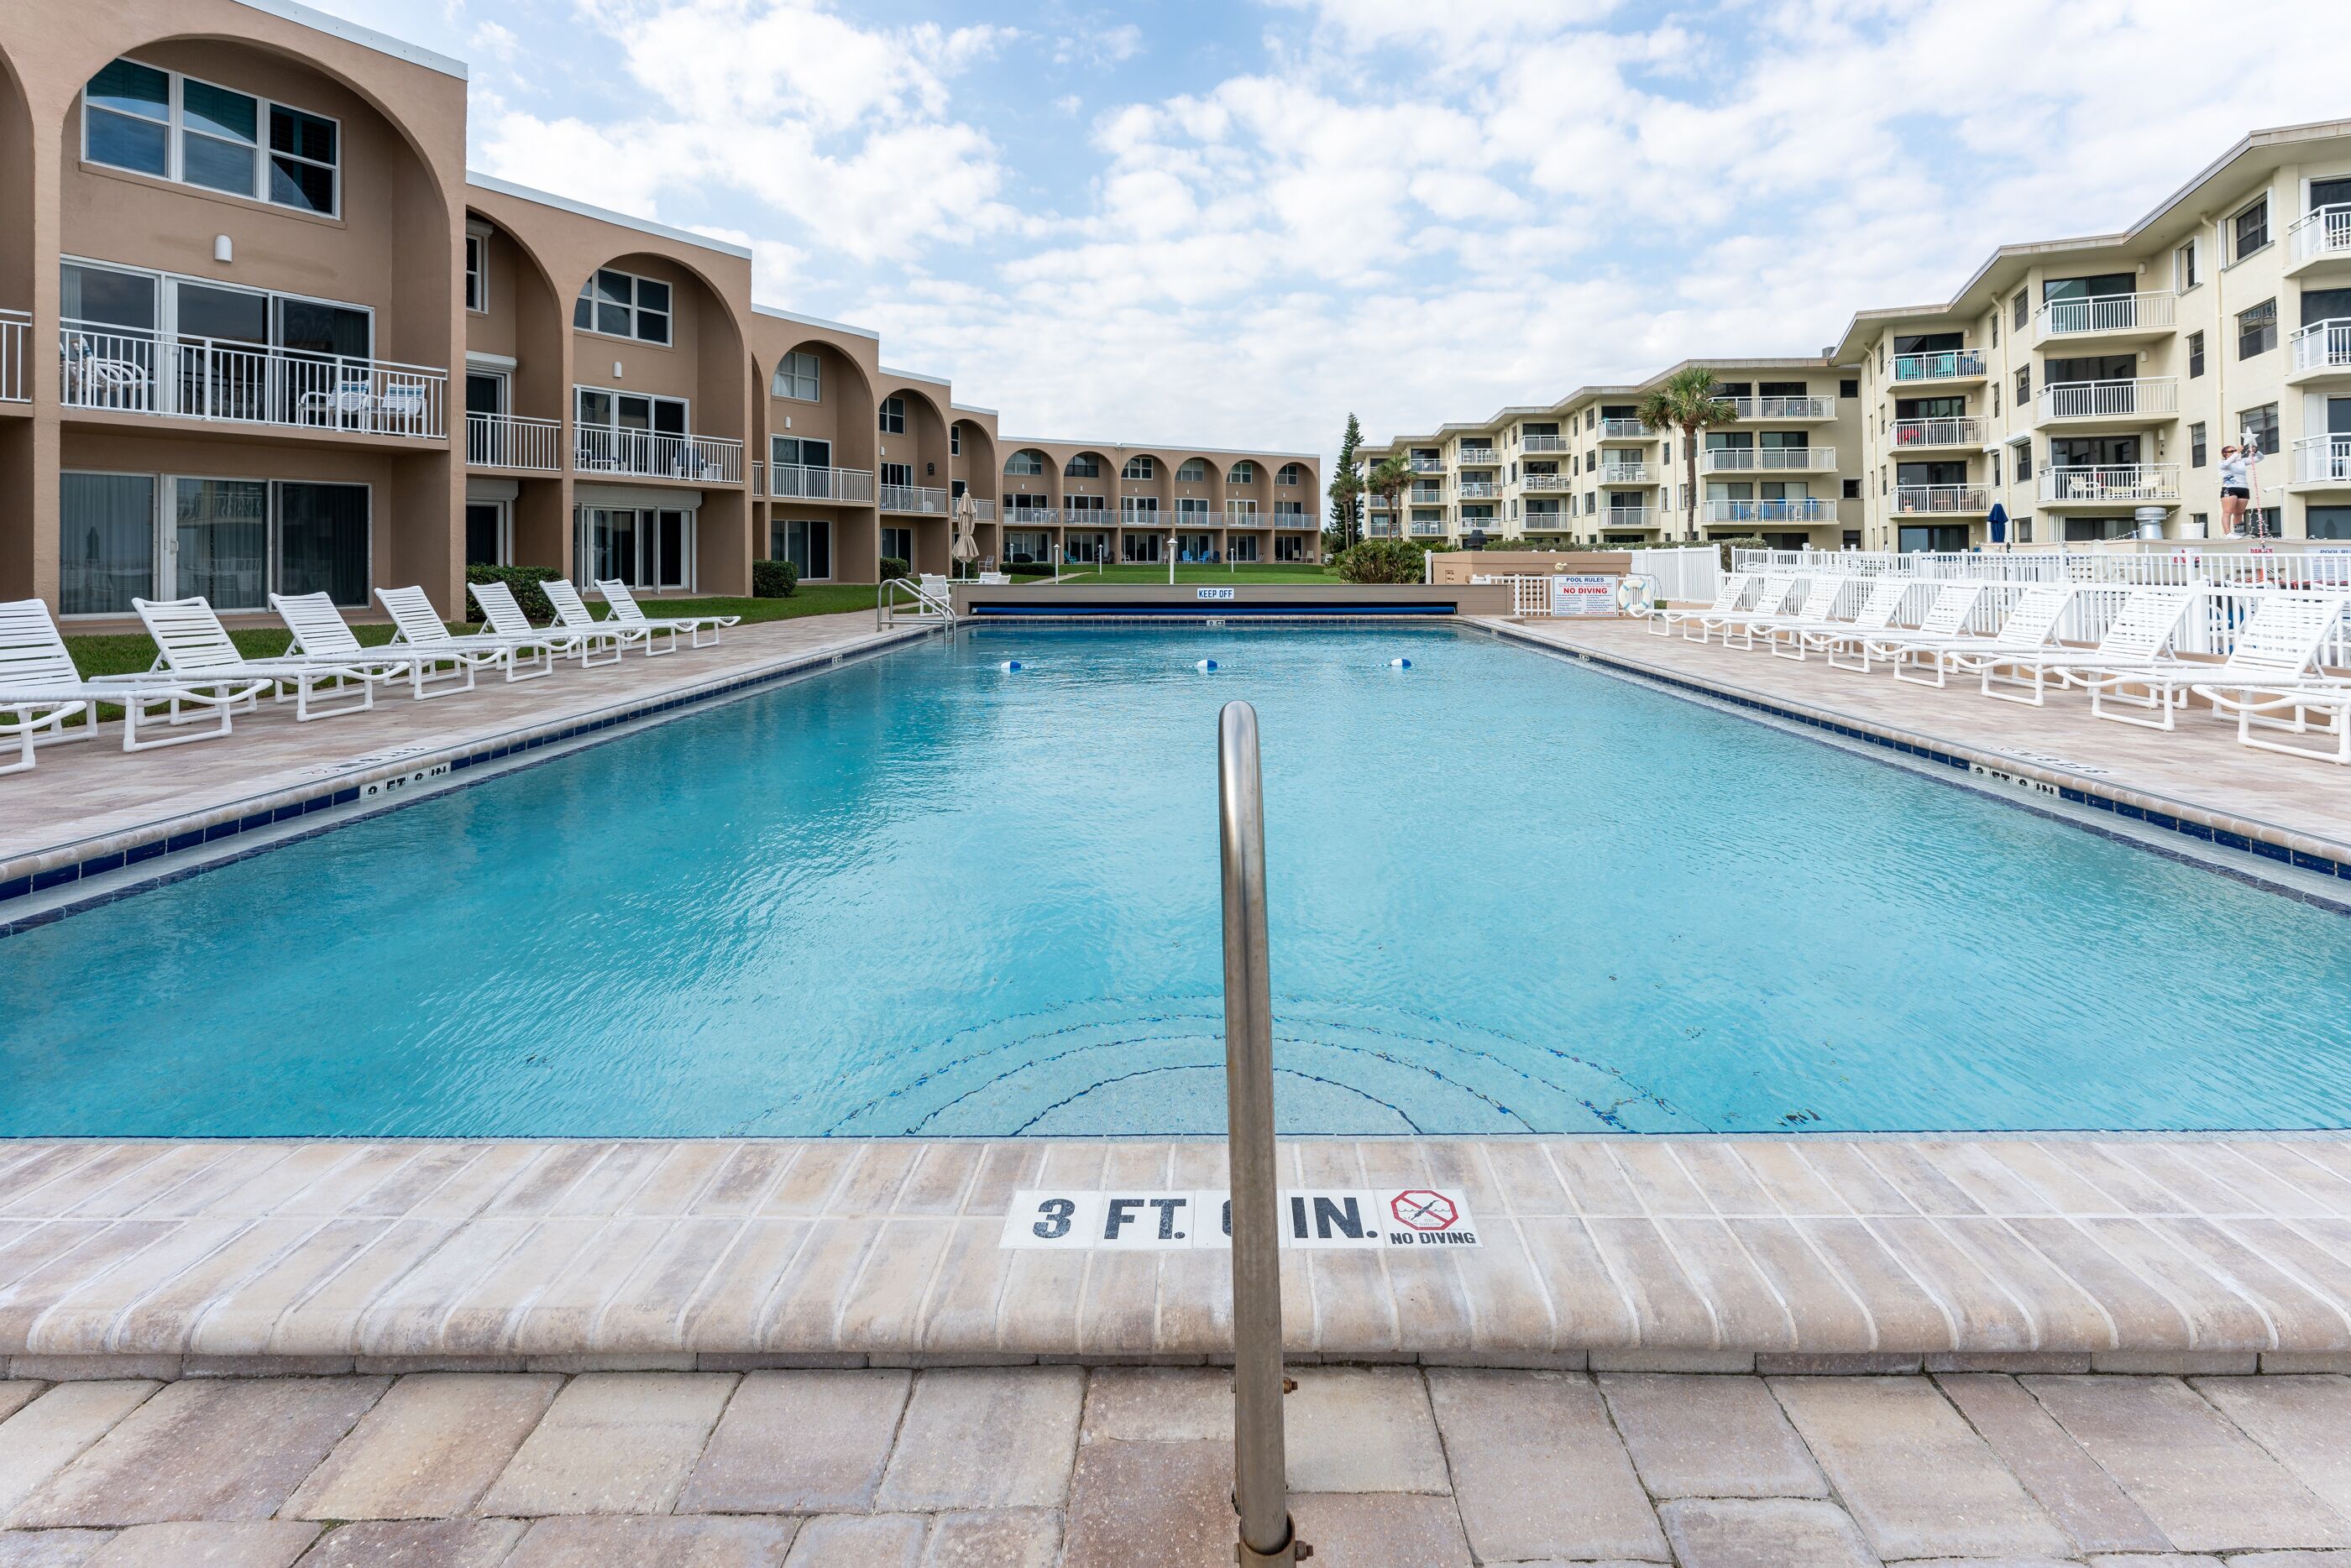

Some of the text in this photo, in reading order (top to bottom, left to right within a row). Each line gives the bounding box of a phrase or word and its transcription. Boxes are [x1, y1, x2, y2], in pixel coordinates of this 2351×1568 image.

[1198, 589, 1233, 598] KEEP OFF
[1032, 1198, 1076, 1239] 3
[1103, 1199, 1187, 1240] FT.
[1291, 1197, 1379, 1239] IN.
[1390, 1231, 1477, 1245] NO DIVING
